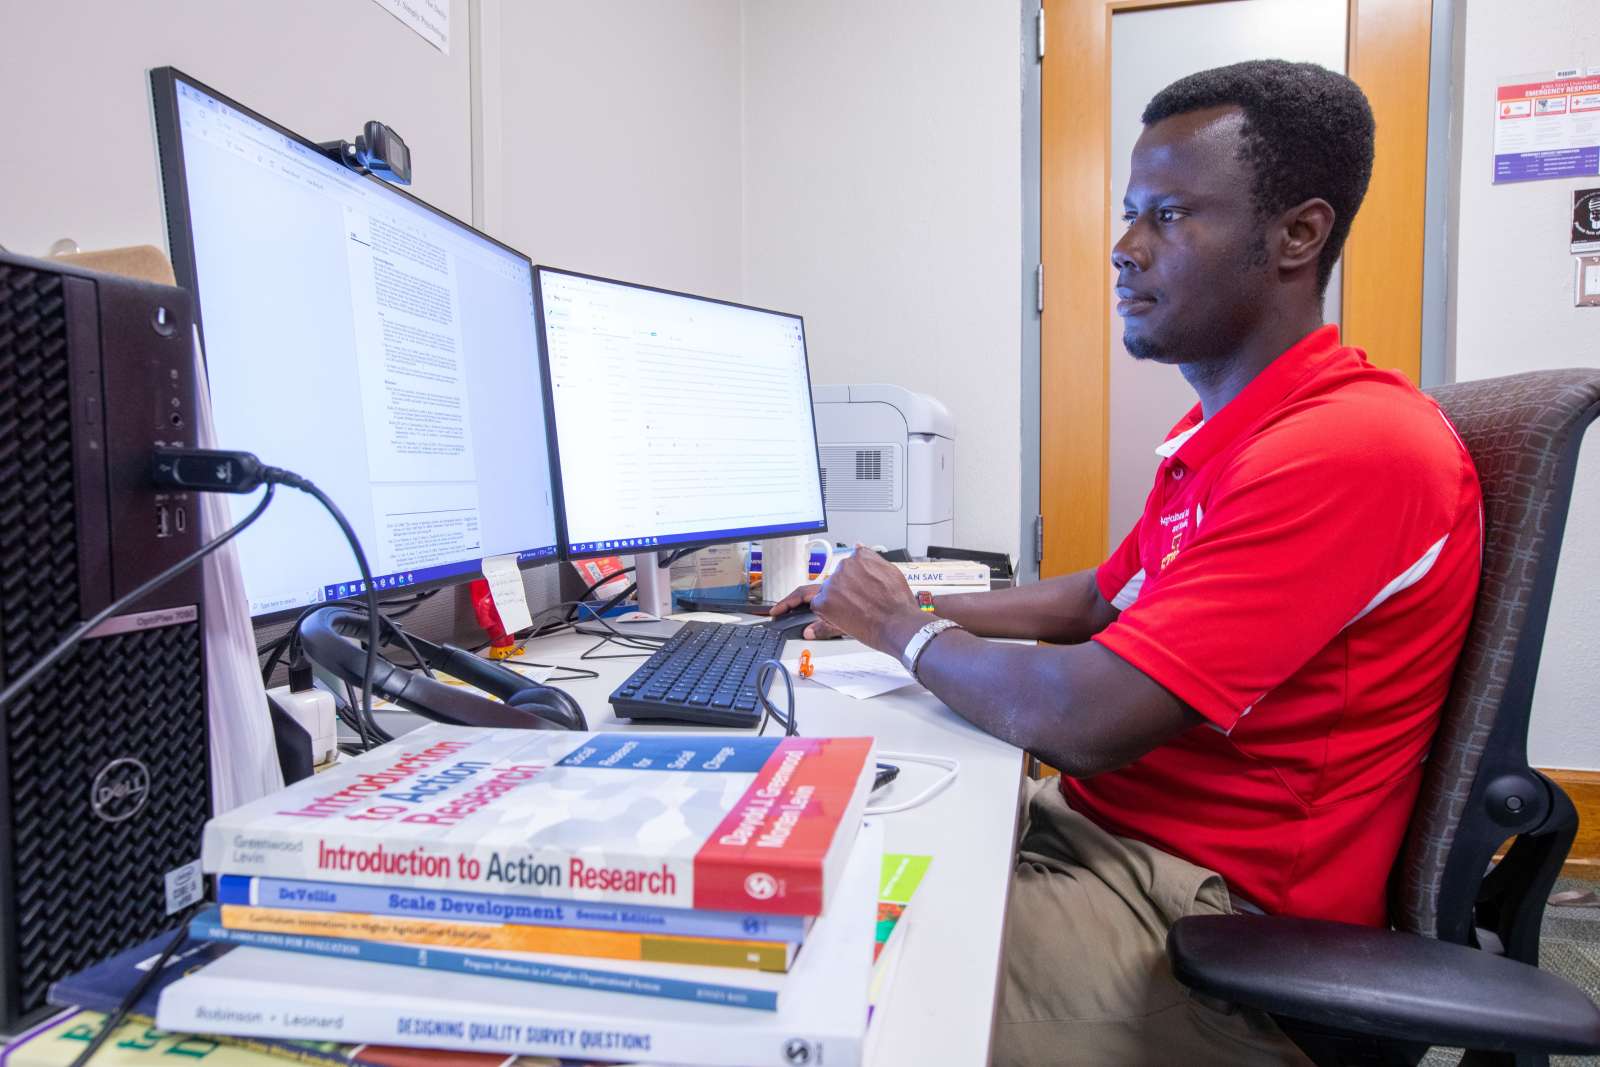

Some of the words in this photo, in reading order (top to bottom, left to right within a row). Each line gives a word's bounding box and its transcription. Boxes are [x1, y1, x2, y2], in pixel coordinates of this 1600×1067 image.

[1525, 87, 1564, 97] EMERGENCY
[907, 573, 920, 581] AN
[922, 573, 944, 581] SAVE
[598, 740, 640, 767] Research
[667, 750, 697, 769] Social
[702, 746, 736, 770] Change
[99, 777, 144, 806] DELL
[276, 740, 473, 819] Introduction
[344, 804, 408, 822] to
[379, 761, 492, 804] Action
[399, 764, 546, 826] Research
[233, 834, 303, 853] Greenwood
[233, 850, 265, 865] Levin
[318, 838, 450, 879] Introduction
[457, 854, 481, 881] to
[486, 851, 562, 887] Action
[569, 857, 676, 896] Research
[279, 886, 337, 903] DeVellis
[388, 893, 436, 911] Scale
[441, 896, 564, 922] Development
[576, 909, 618, 923] Second
[622, 911, 665, 926] Edition
[196, 1004, 263, 1024] Robinson
[283, 1010, 344, 1031] Leonard
[398, 1016, 465, 1040] DESIGNING
[470, 1021, 521, 1044] QUALITY
[526, 1026, 575, 1046] SURVEY
[580, 1029, 652, 1052] QUESTIONS
